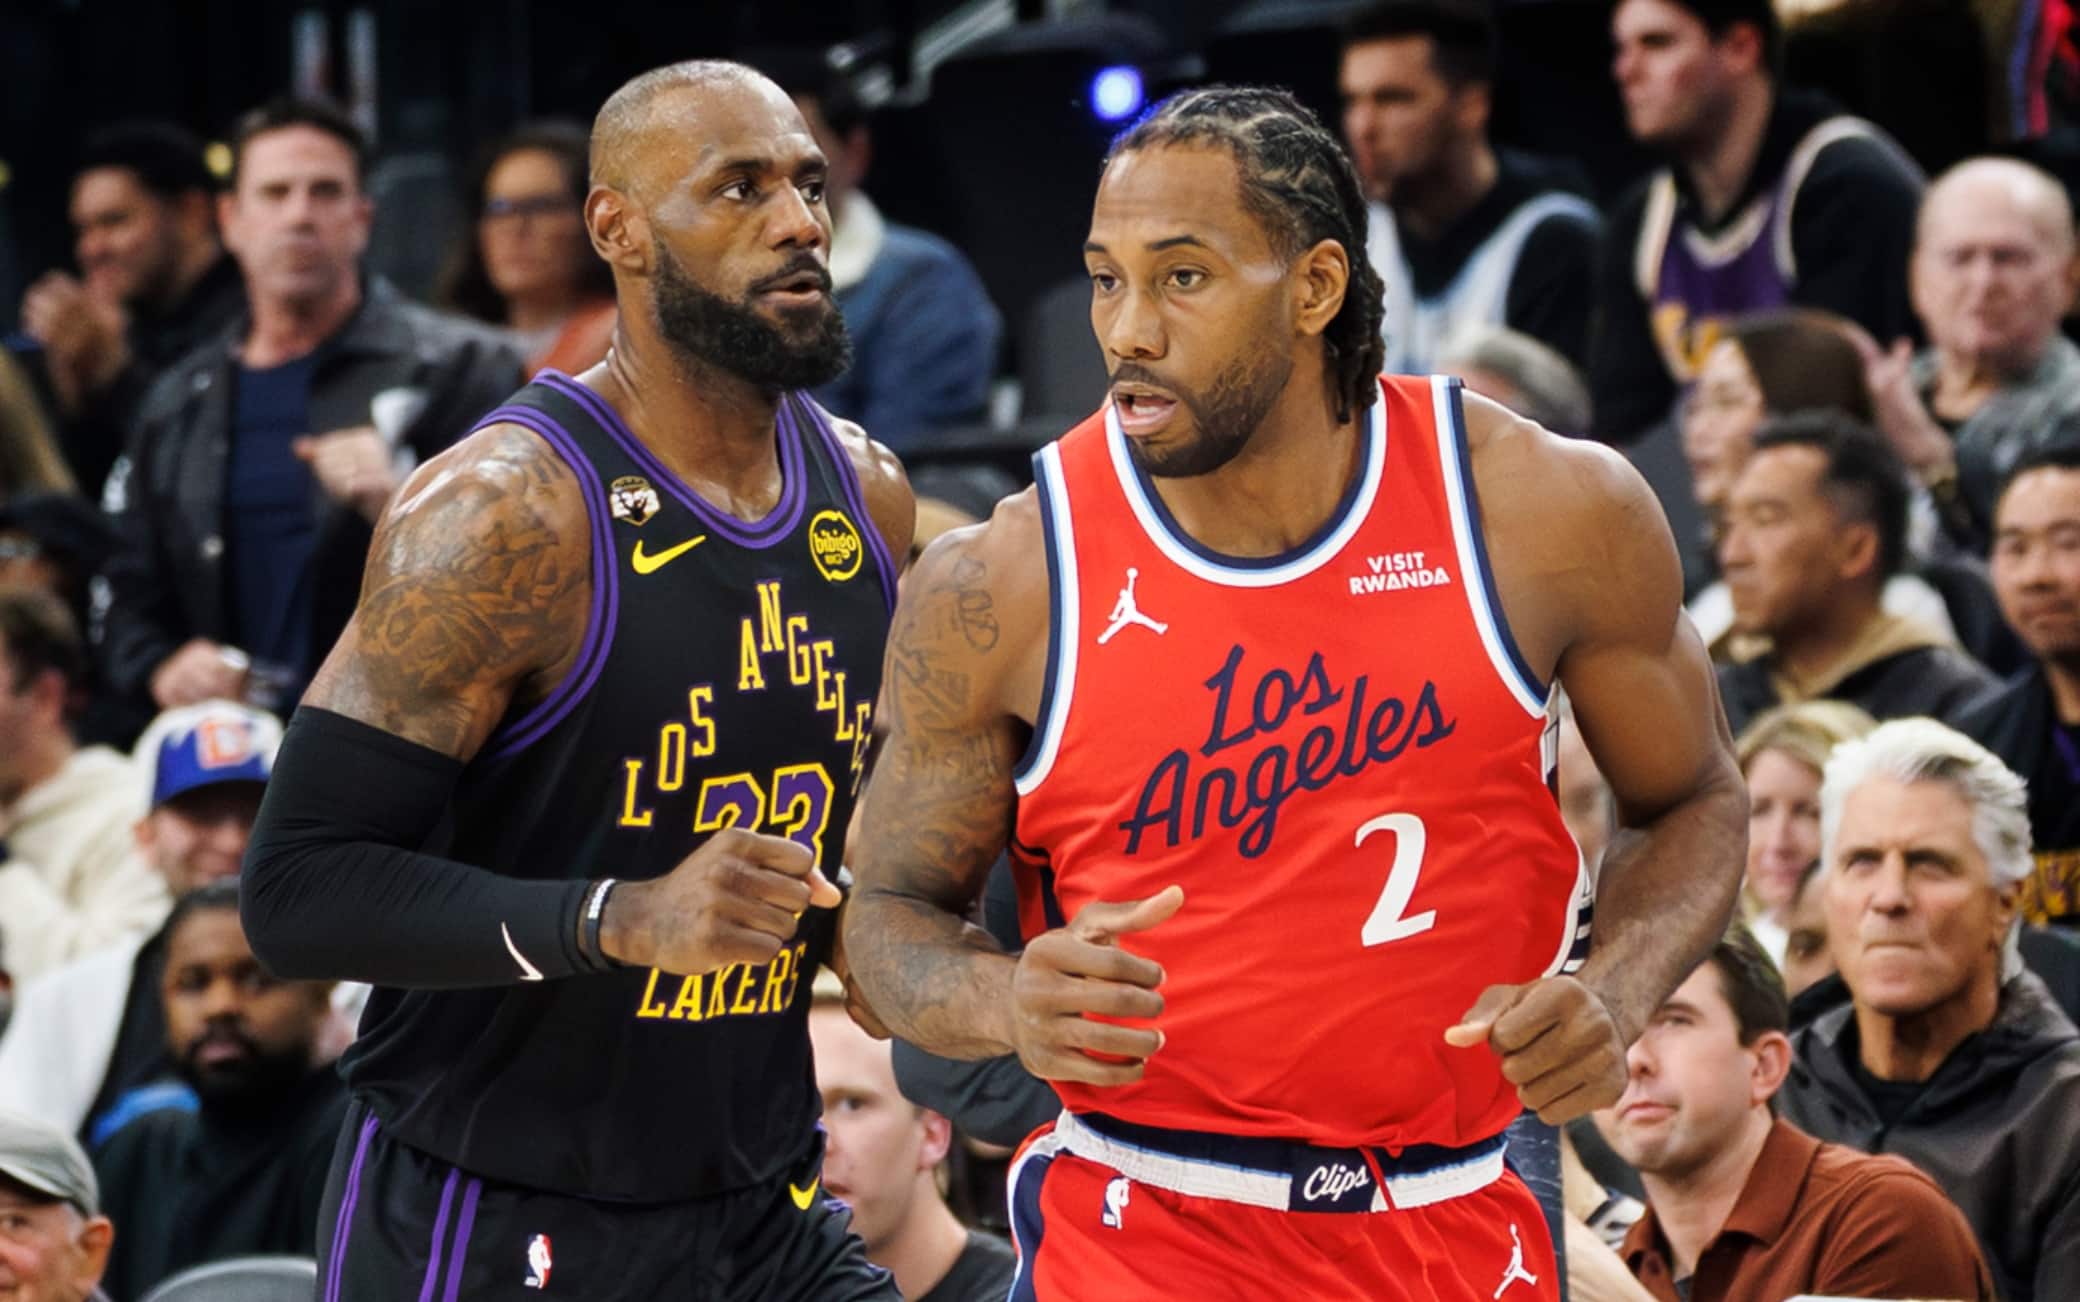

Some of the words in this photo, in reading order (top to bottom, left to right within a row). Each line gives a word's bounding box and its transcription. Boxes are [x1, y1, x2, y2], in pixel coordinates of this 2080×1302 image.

[1349, 567, 1451, 595] RWANDA
[1367, 551, 1425, 573] VISIT
[1199, 644, 1344, 758] Los
[619, 686, 716, 827] LOS
[1118, 674, 1457, 859] Angeles
[1355, 812, 1437, 947] 2
[636, 942, 807, 1021] LAKERS
[1303, 1163, 1370, 1202] Clips
